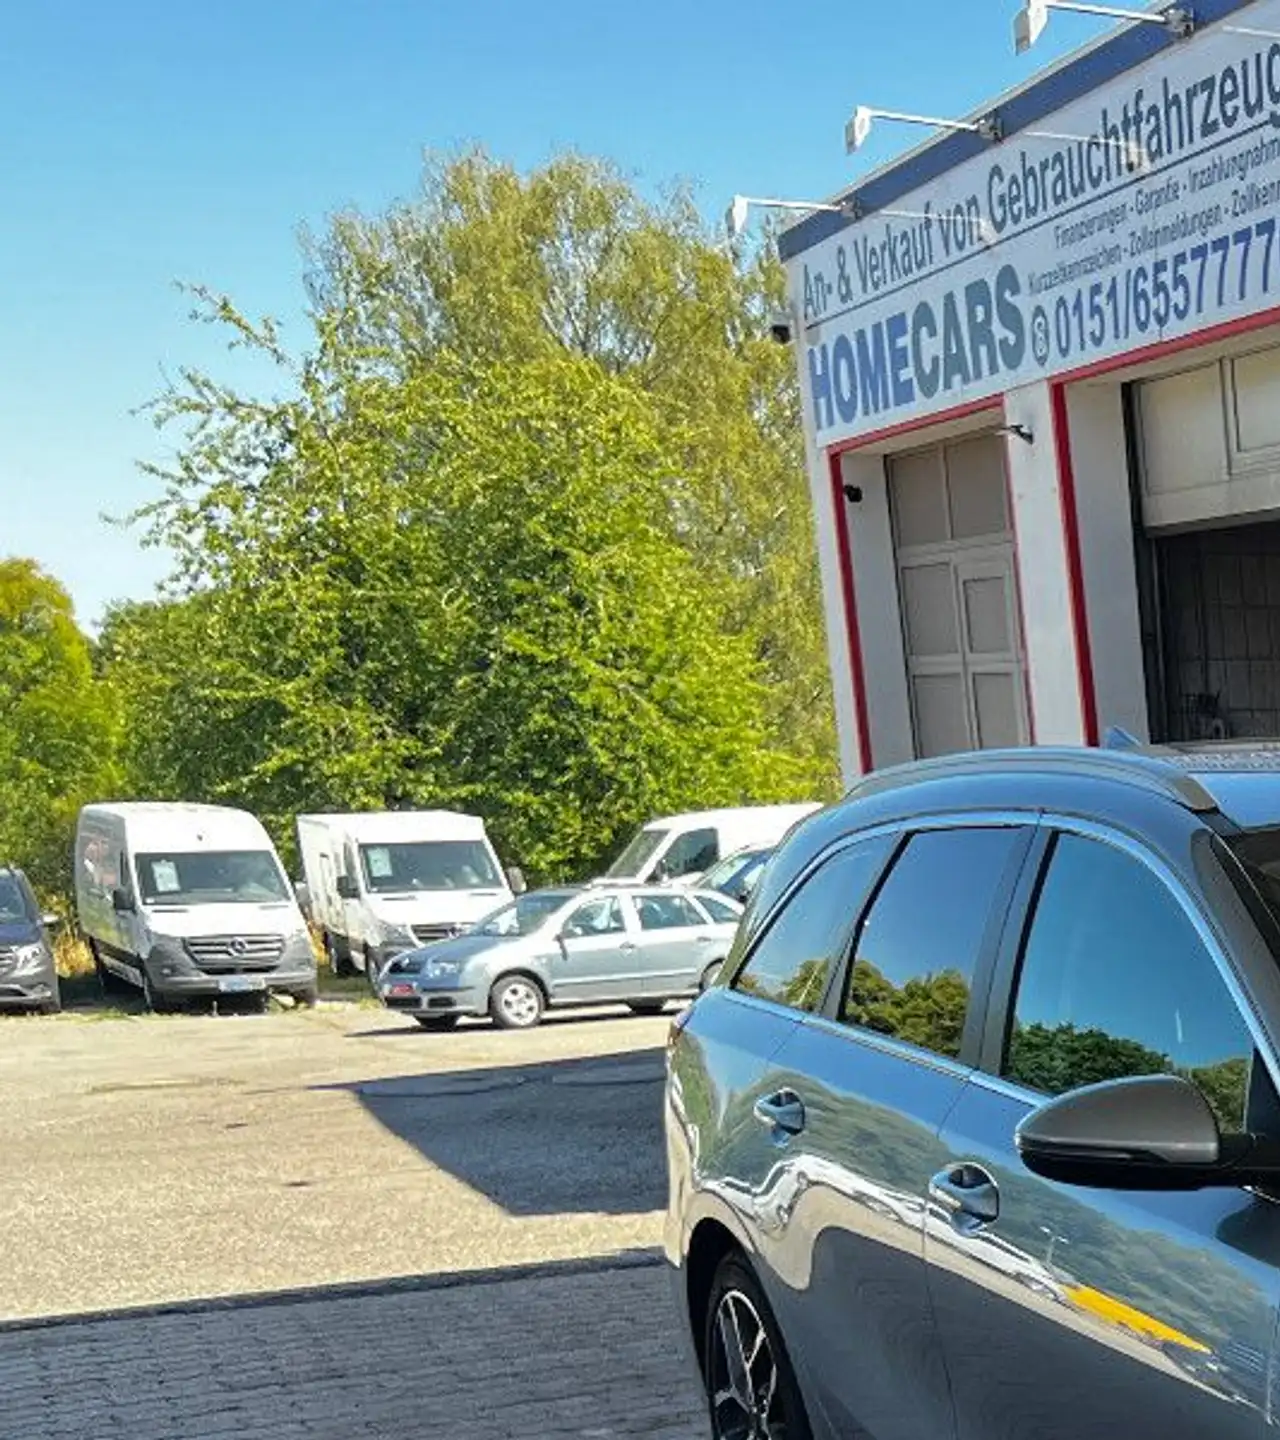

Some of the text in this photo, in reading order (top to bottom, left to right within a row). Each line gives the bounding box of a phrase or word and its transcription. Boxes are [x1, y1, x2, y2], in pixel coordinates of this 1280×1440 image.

[804, 265, 832, 320] An-
[837, 246, 853, 303] &
[854, 201, 933, 293] Verkauf
[939, 194, 982, 256] von
[807, 264, 1026, 430] HOMECARS
